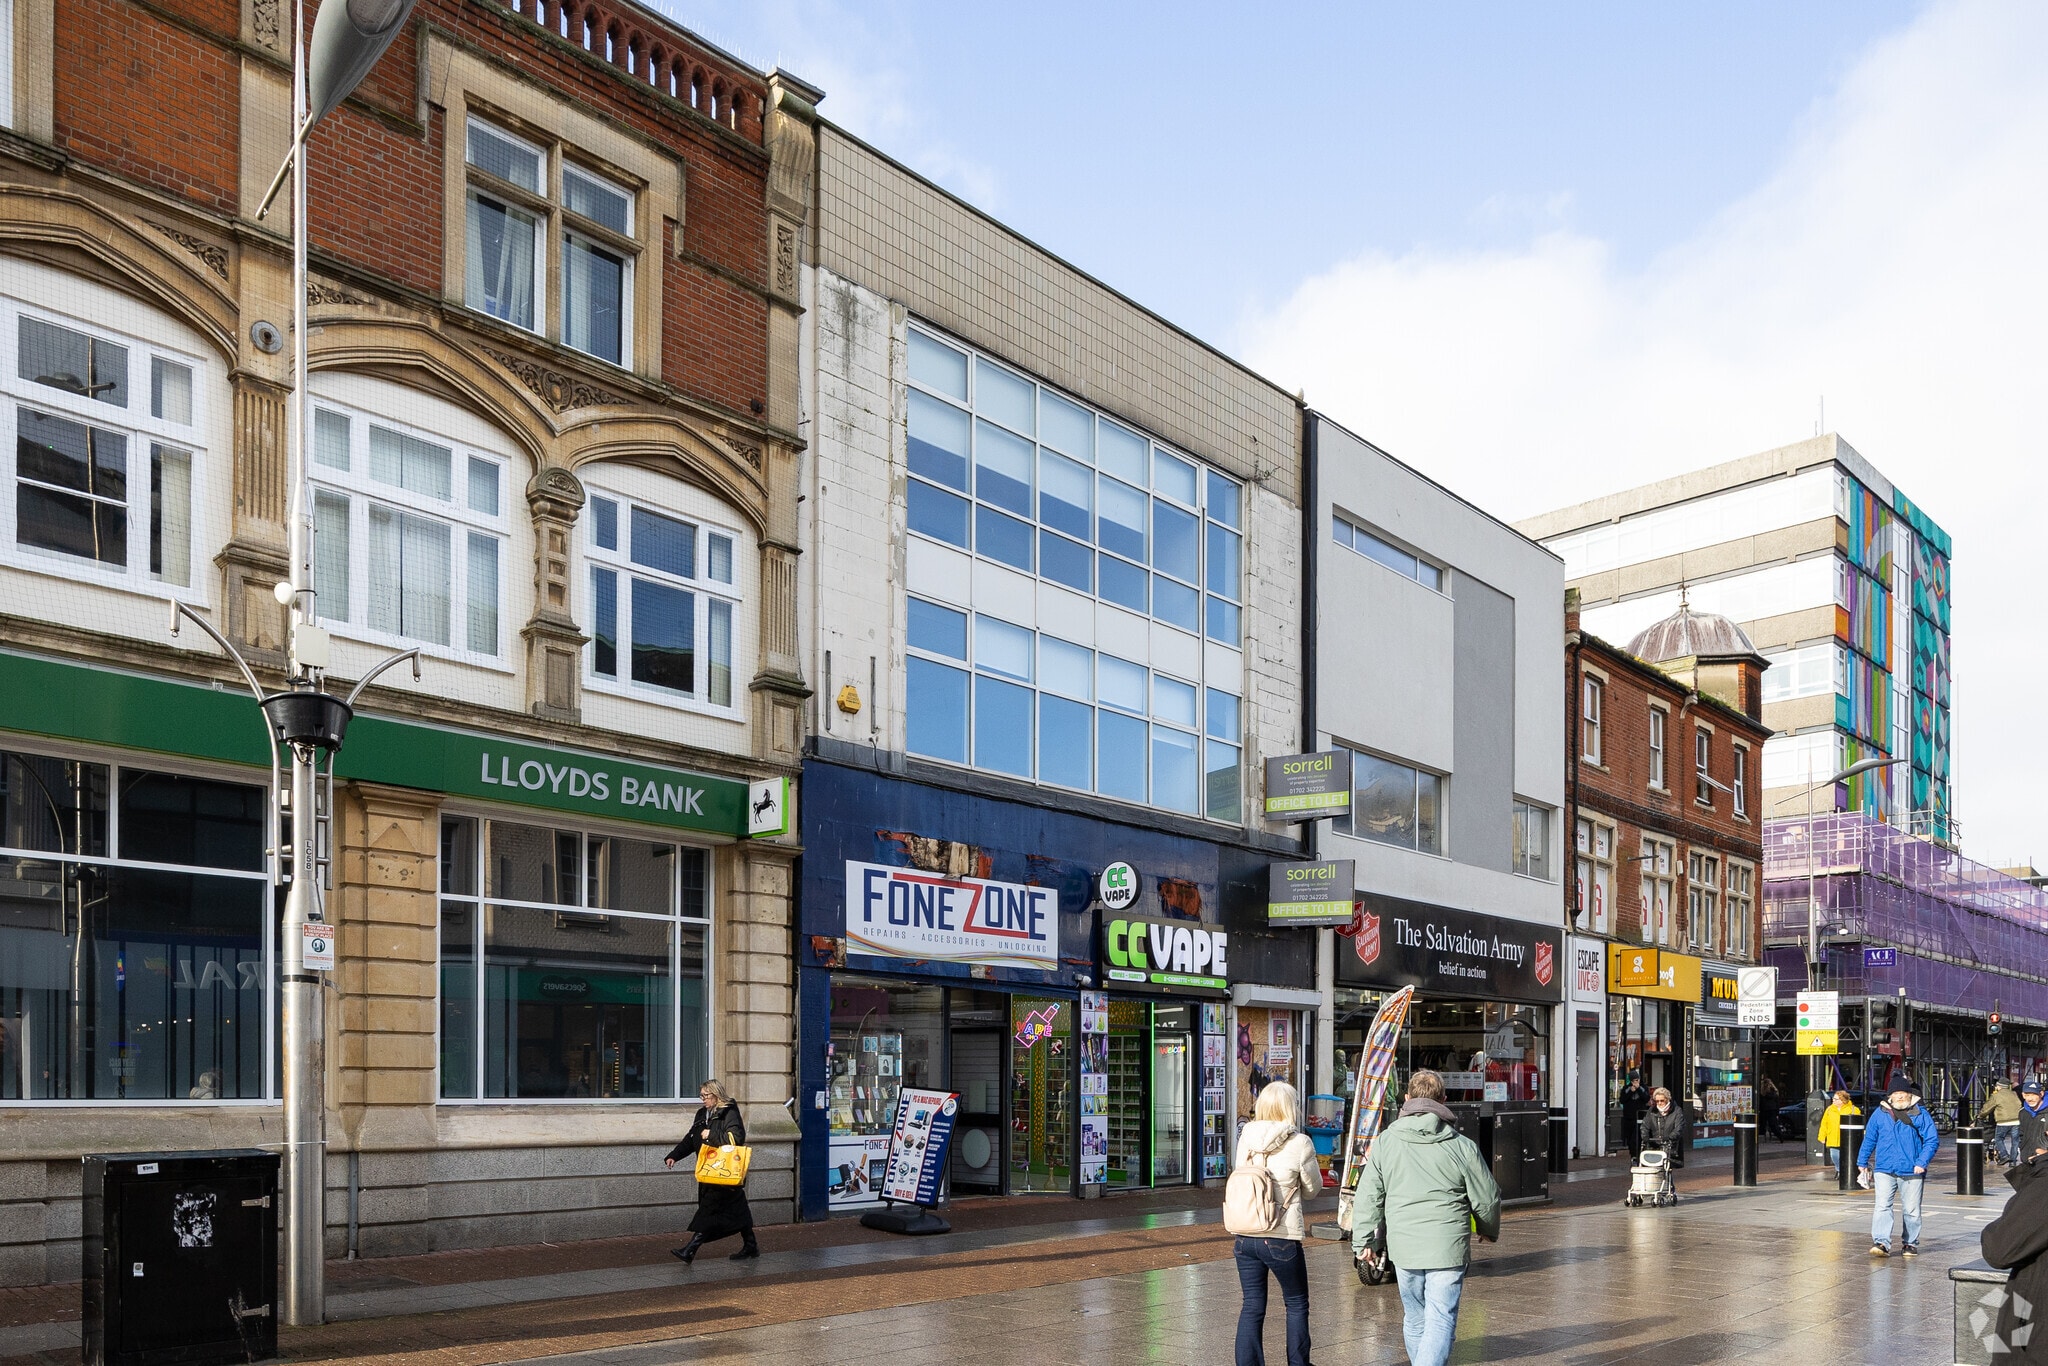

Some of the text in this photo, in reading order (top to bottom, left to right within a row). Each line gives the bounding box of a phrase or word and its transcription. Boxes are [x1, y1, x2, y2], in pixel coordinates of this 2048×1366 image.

[1283, 755, 1332, 775] sorrell
[481, 753, 705, 816] LLOYDS BANK
[1270, 793, 1345, 810] OFFICE TO LET
[1107, 866, 1127, 888] CC
[1286, 864, 1336, 881] sorrell
[863, 868, 1046, 941] FONE ZONE
[1105, 888, 1130, 902] VAPE
[1272, 904, 1309, 915] OFFICE
[1311, 904, 1325, 914] TO
[1327, 903, 1347, 913] LET
[863, 927, 1047, 953] REPAIRS ACCESSORIES UNLOCKING
[1108, 919, 1147, 969] CC
[1357, 925, 1379, 949] SALVATION
[1364, 938, 1378, 958] ARMY
[1393, 917, 1525, 968] The Salvation Army
[1150, 923, 1228, 977] VAPE
[1577, 949, 1600, 972] ESCAPE
[1868, 950, 1893, 960] ACE
[1438, 960, 1487, 980] belief in action
[1540, 965, 1551, 980] ARMY
[1577, 970, 1591, 992] LIVE
[1711, 977, 1738, 1000] MUN
[1015, 1021, 1053, 1037] VAPE
[1742, 1014, 1771, 1023] ENDS
[884, 1146, 900, 1196] FONE
